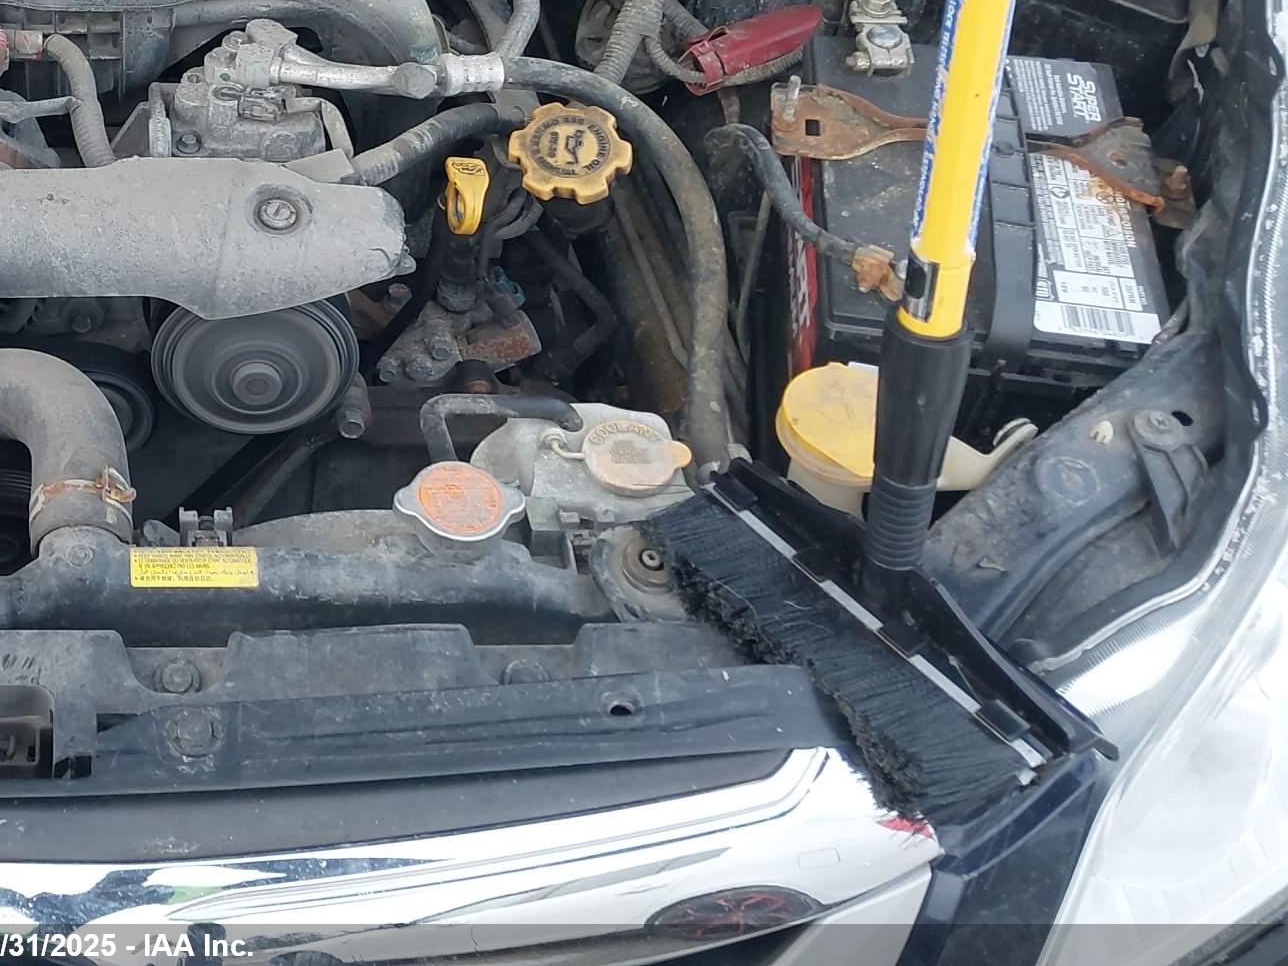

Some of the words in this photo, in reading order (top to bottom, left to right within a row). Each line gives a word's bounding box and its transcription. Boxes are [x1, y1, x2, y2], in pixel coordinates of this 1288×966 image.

[1066, 72, 1090, 121] START
[1083, 80, 1102, 122] SUPER
[588, 419, 661, 445] COOLANT
